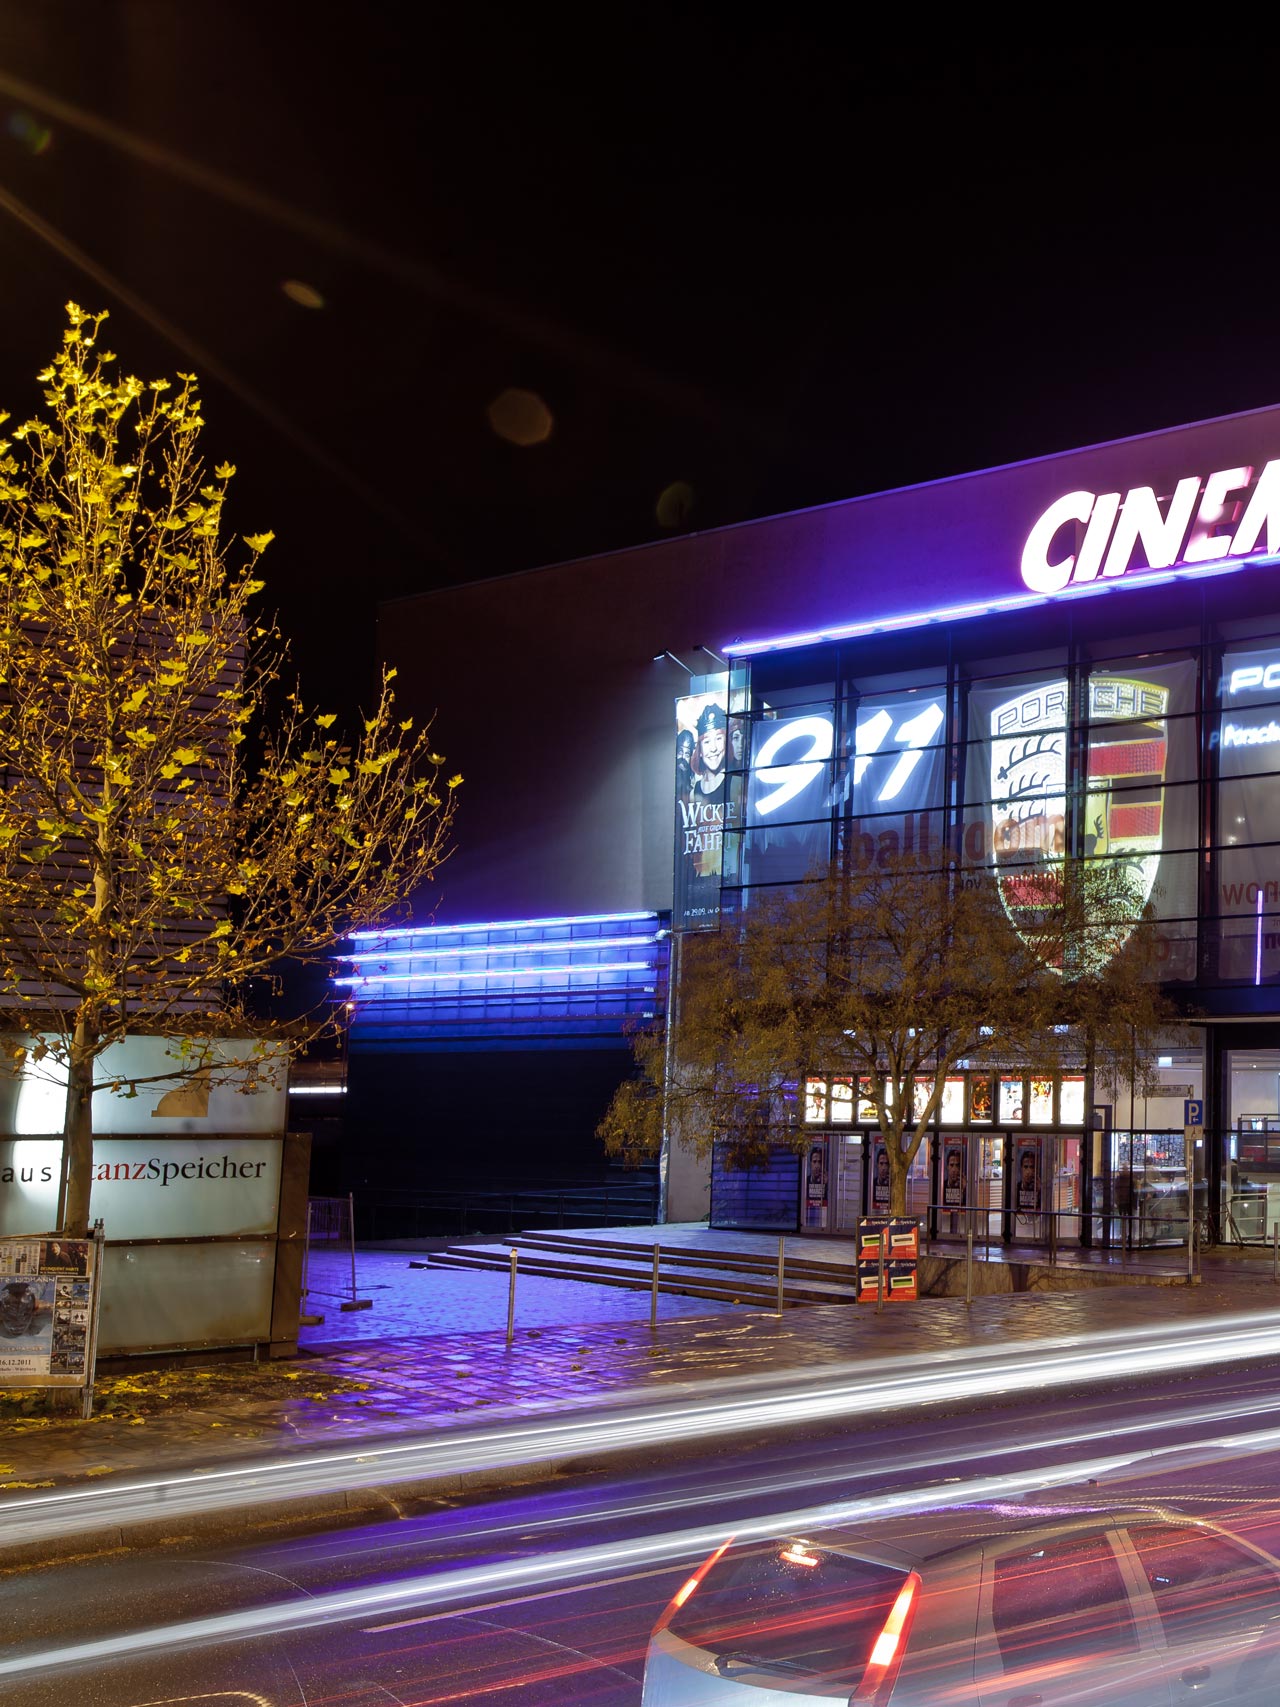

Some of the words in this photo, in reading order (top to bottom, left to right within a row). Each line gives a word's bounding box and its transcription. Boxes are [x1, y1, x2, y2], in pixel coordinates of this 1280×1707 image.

[997, 685, 1163, 736] PORCHE
[754, 703, 945, 815] 911
[678, 800, 738, 829] WICKE
[1188, 1103, 1199, 1124] P
